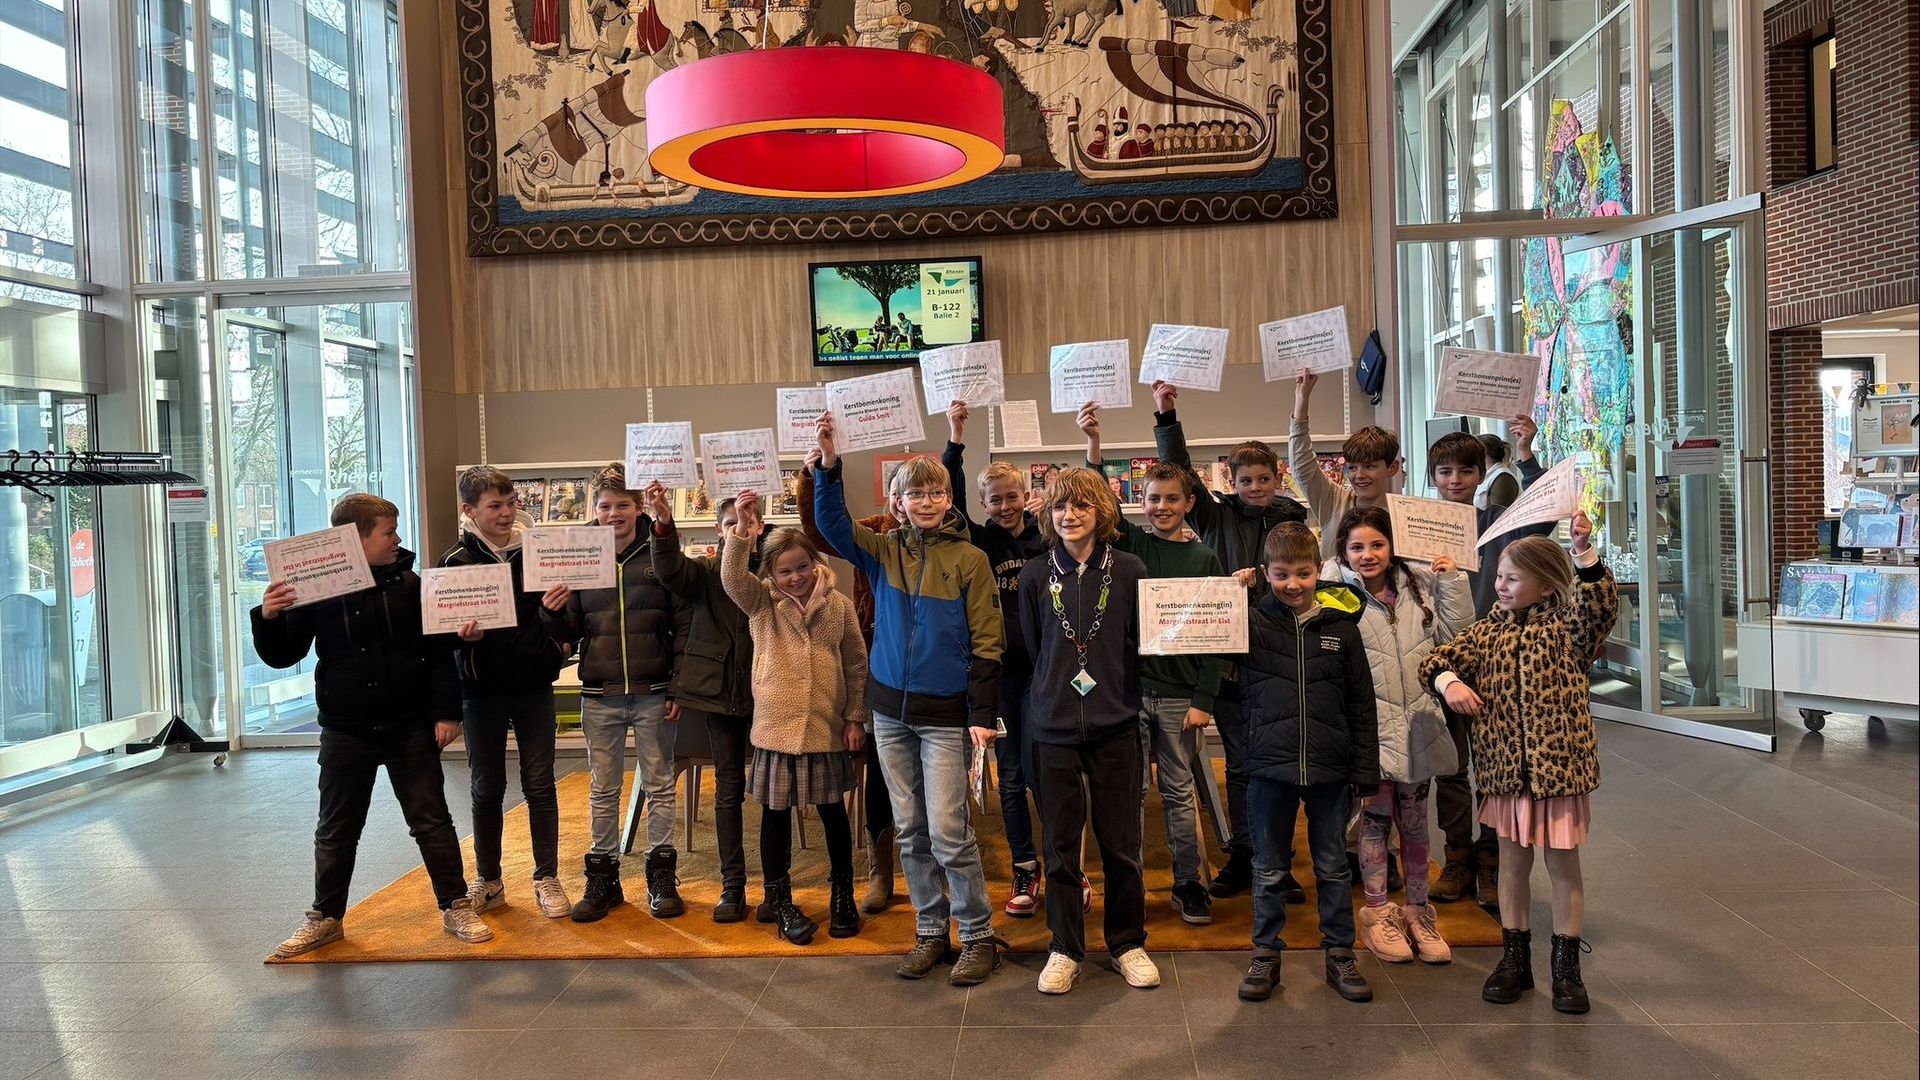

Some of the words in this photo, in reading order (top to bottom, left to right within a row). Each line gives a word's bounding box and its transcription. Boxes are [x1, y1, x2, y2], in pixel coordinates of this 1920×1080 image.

[938, 288, 965, 296] januari
[932, 303, 961, 312] B-122
[843, 395, 900, 410] Kerstbomenkoning
[858, 414, 876, 422] Guido
[76, 540, 86, 550] de
[283, 564, 294, 572] Elst
[435, 584, 500, 595] Kerstbomenkoning(in)
[437, 602, 480, 610] Margrietstraat
[1156, 601, 1232, 610] Kerstbomenkoning(in)
